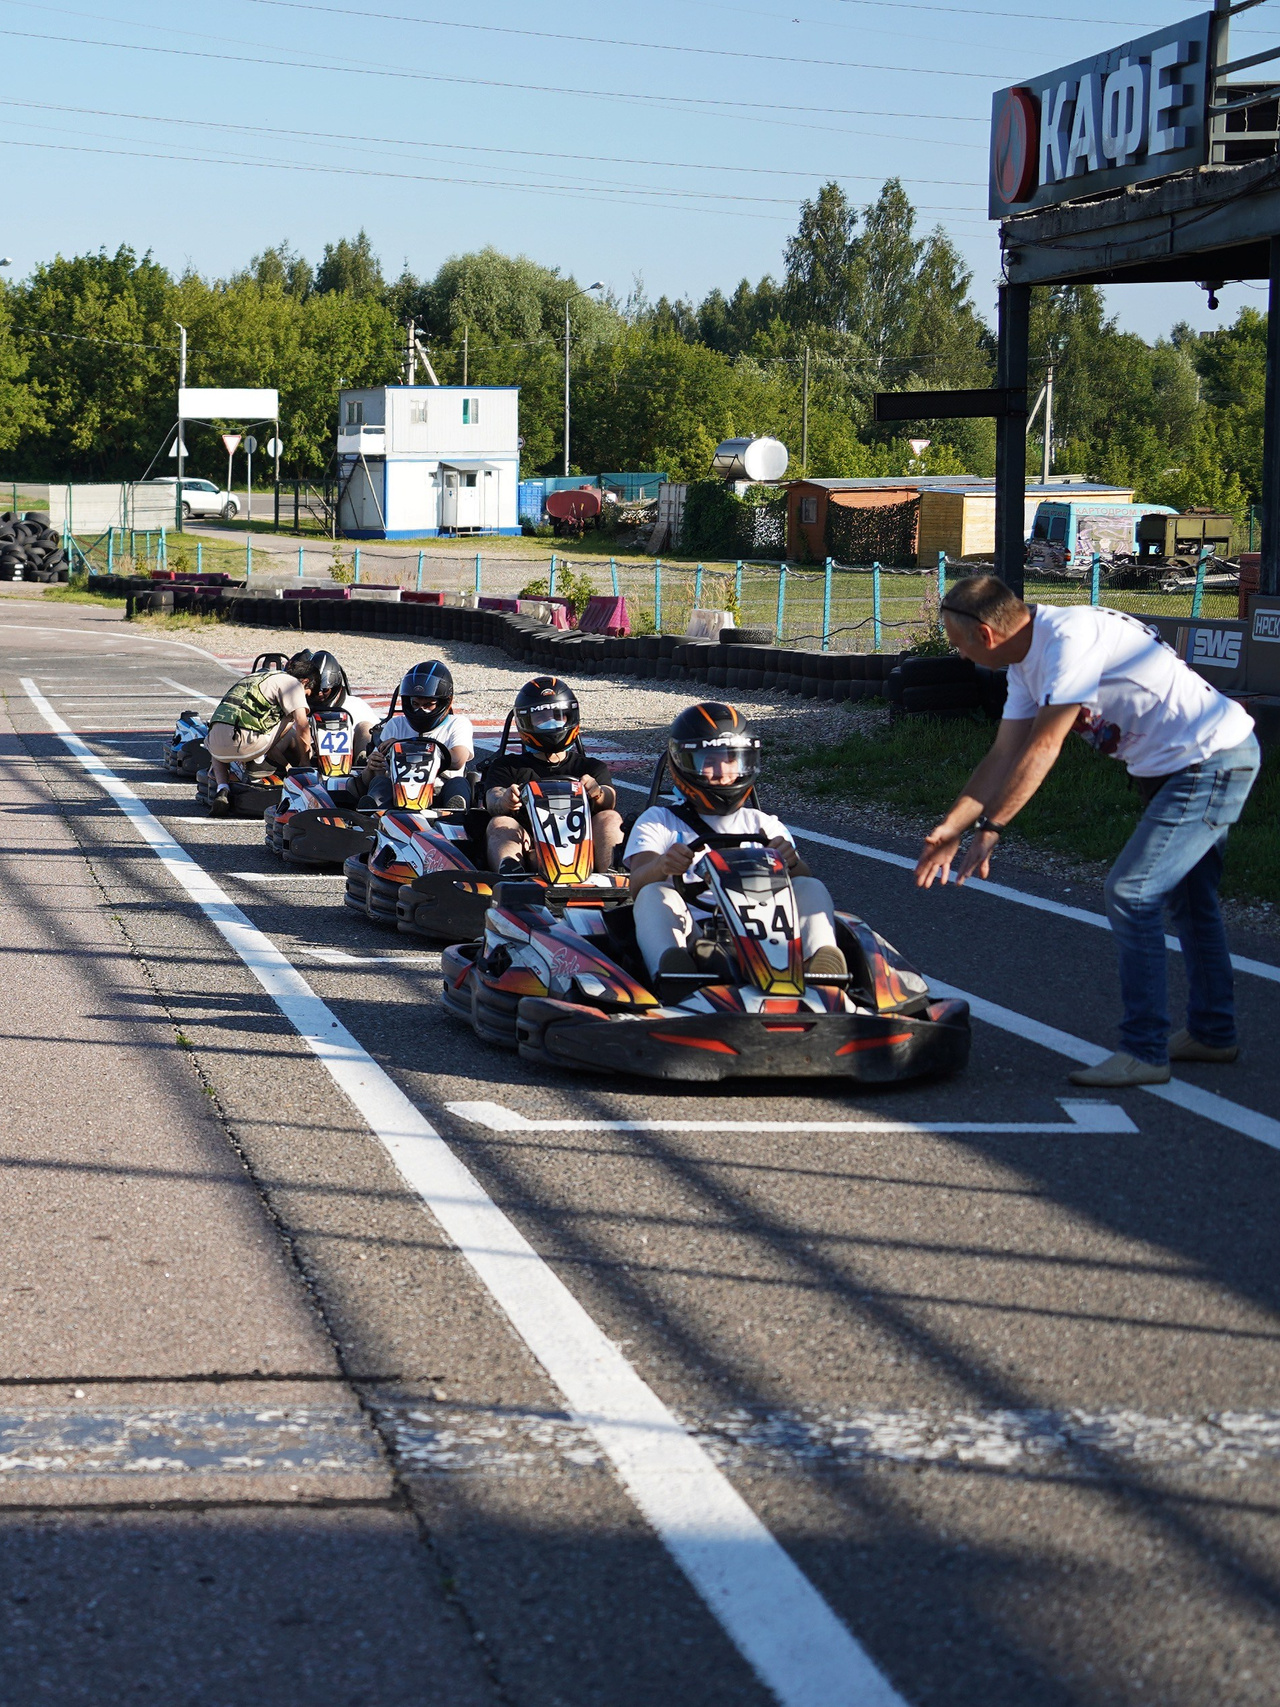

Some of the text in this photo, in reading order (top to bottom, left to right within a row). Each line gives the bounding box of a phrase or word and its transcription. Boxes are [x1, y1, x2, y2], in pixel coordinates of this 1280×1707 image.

[1038, 41, 1194, 186] КАФЕ
[1075, 507, 1137, 516] КАРТОДРОМ
[1194, 628, 1243, 663] SWS
[320, 732, 349, 754] 42
[397, 760, 430, 783] 25
[542, 811, 586, 848] 19
[738, 904, 794, 941] 54
